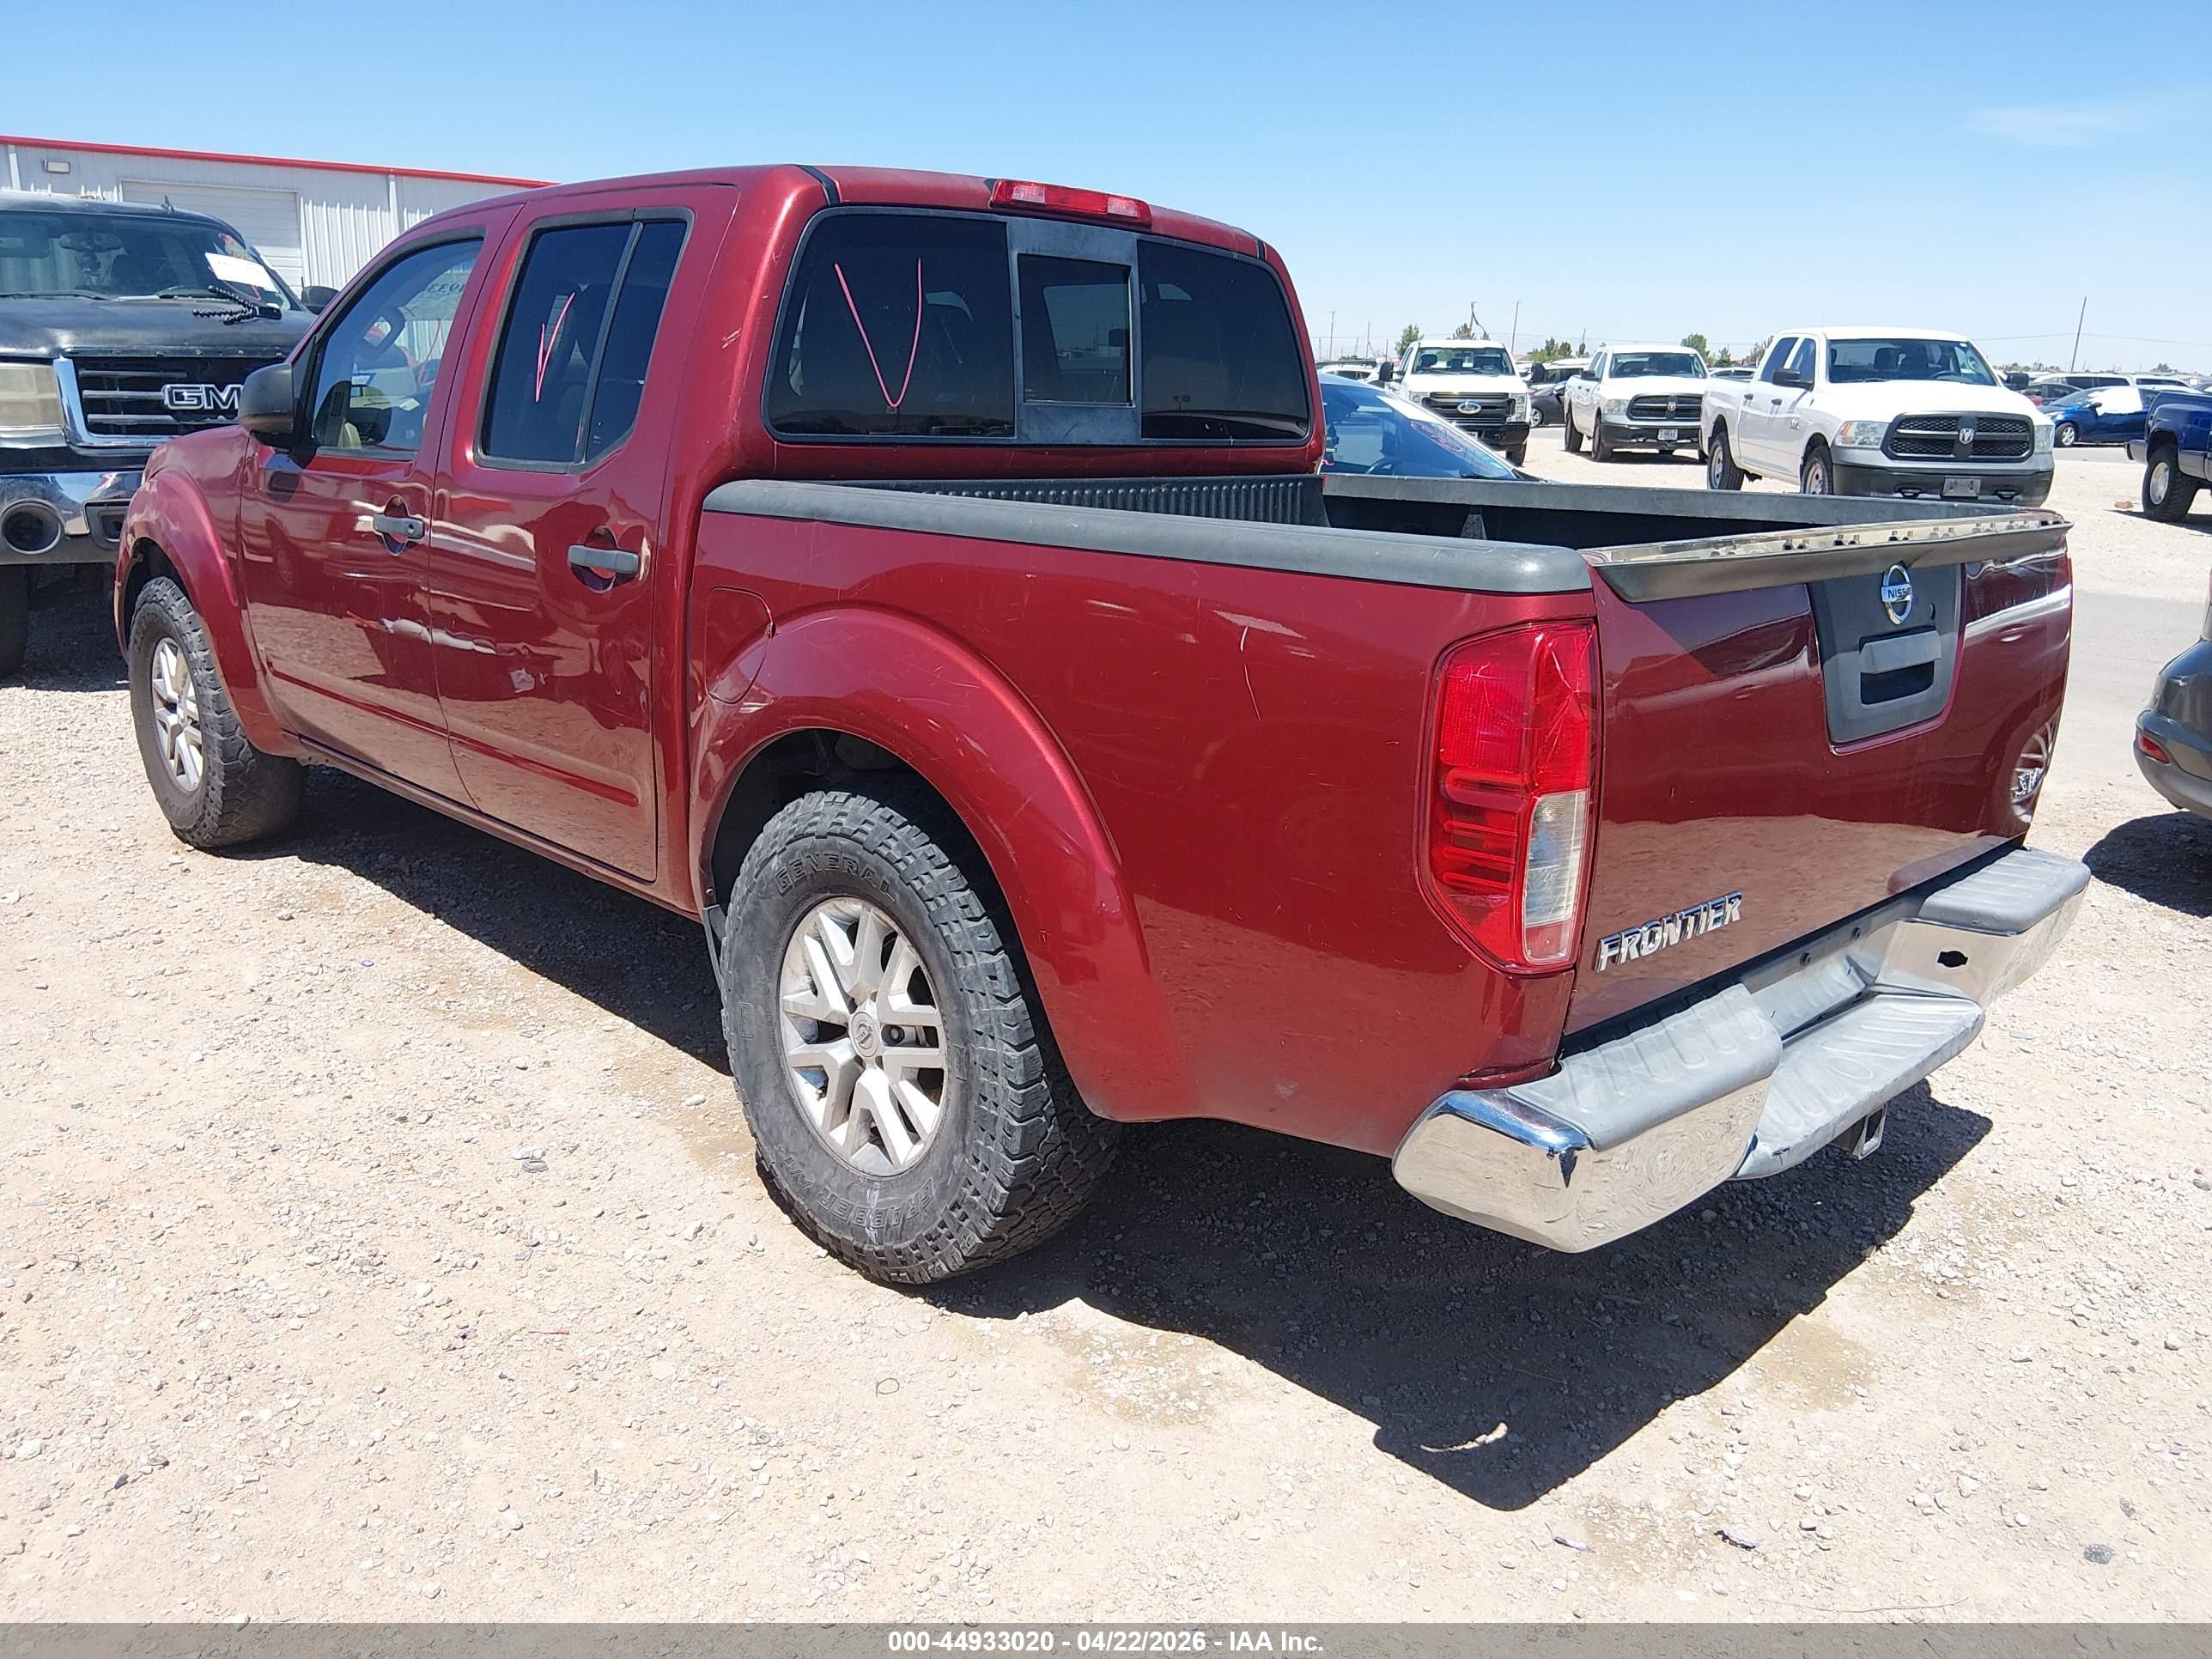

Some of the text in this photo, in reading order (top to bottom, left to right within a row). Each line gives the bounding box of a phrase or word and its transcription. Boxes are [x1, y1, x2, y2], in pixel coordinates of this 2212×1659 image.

[164, 384, 242, 410] GM
[775, 853, 896, 902] GENERAL
[1594, 890, 1742, 973] FRONTIER
